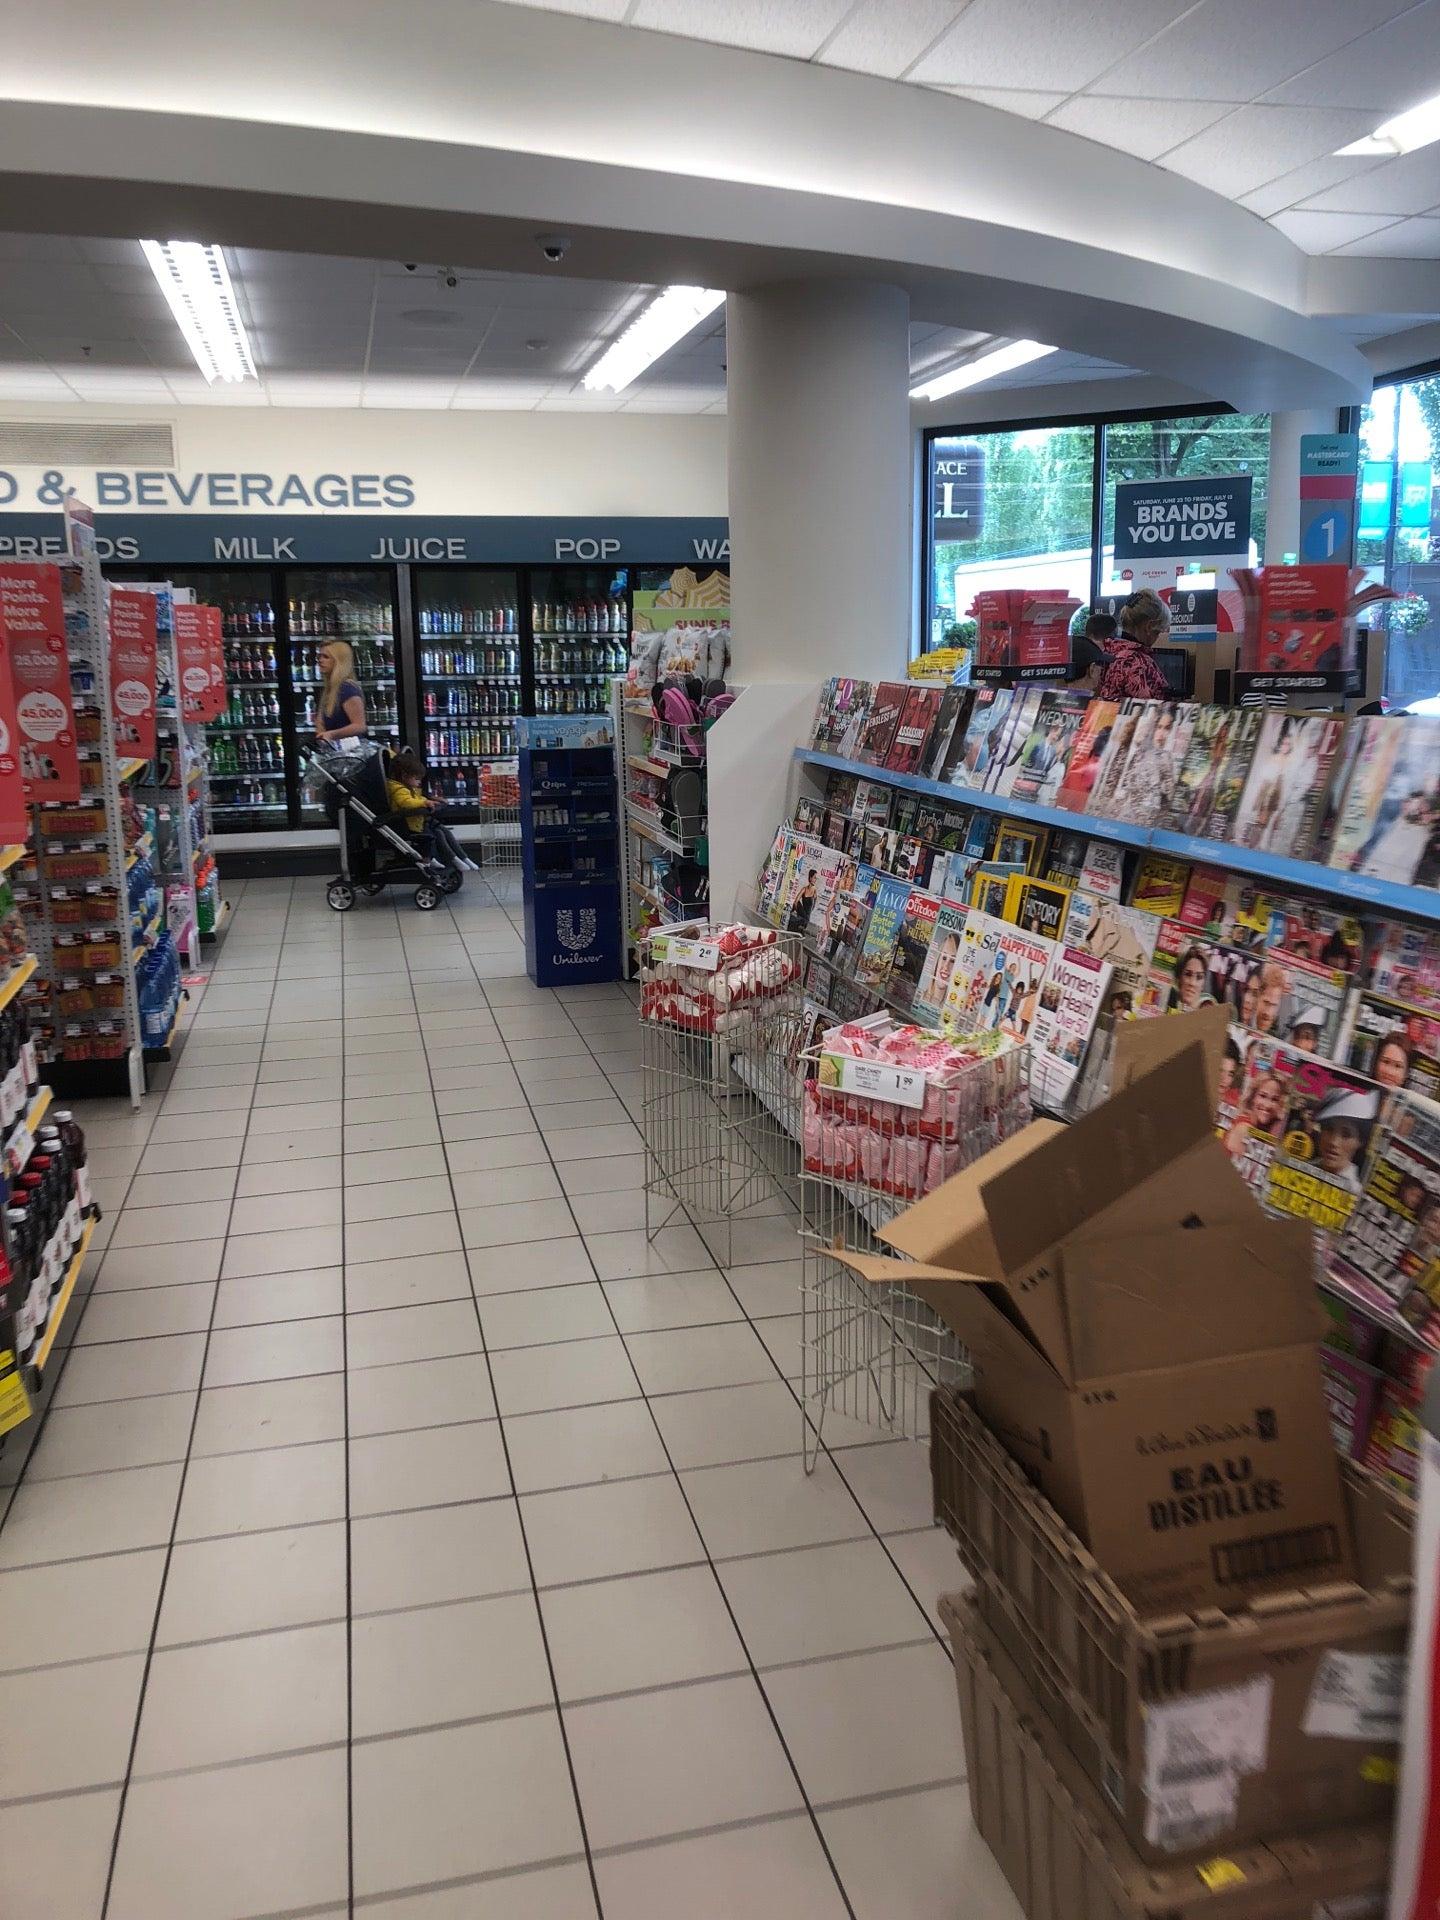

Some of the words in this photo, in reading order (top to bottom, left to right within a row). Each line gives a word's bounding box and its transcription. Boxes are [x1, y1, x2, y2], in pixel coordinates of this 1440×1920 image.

[934, 461, 968, 476] ACE
[37, 470, 76, 505] &
[97, 472, 416, 508] BEVERAGES
[1137, 501, 1228, 524] BRANDS
[1128, 524, 1175, 544] YOU
[1180, 521, 1236, 541] LOVE
[1321, 517, 1335, 557] 1
[213, 536, 298, 560] MILK
[370, 537, 467, 560] JUICE
[554, 538, 621, 560] POP
[0, 577, 37, 590] More
[3, 604, 41, 617] More
[5, 618, 48, 631] Value.
[1021, 669, 1035, 677] GET
[1036, 667, 1066, 676] STARTED
[1250, 677, 1273, 687] GET
[1274, 677, 1327, 687] STARTED
[978, 690, 994, 701] LIFE
[22, 708, 63, 718] 45,000
[1025, 898, 1062, 926] HISTORY
[552, 952, 604, 966] Unilever
[654, 944, 668, 952] SALE
[1000, 935, 1026, 957] HAPPY
[1026, 949, 1050, 966] KIDS
[1051, 962, 1101, 999] Women's
[1062, 988, 1093, 1019] Health
[1055, 1008, 1073, 1030] Over
[1074, 1017, 1089, 1036] 50
[1168, 1455, 1254, 1492] EAU
